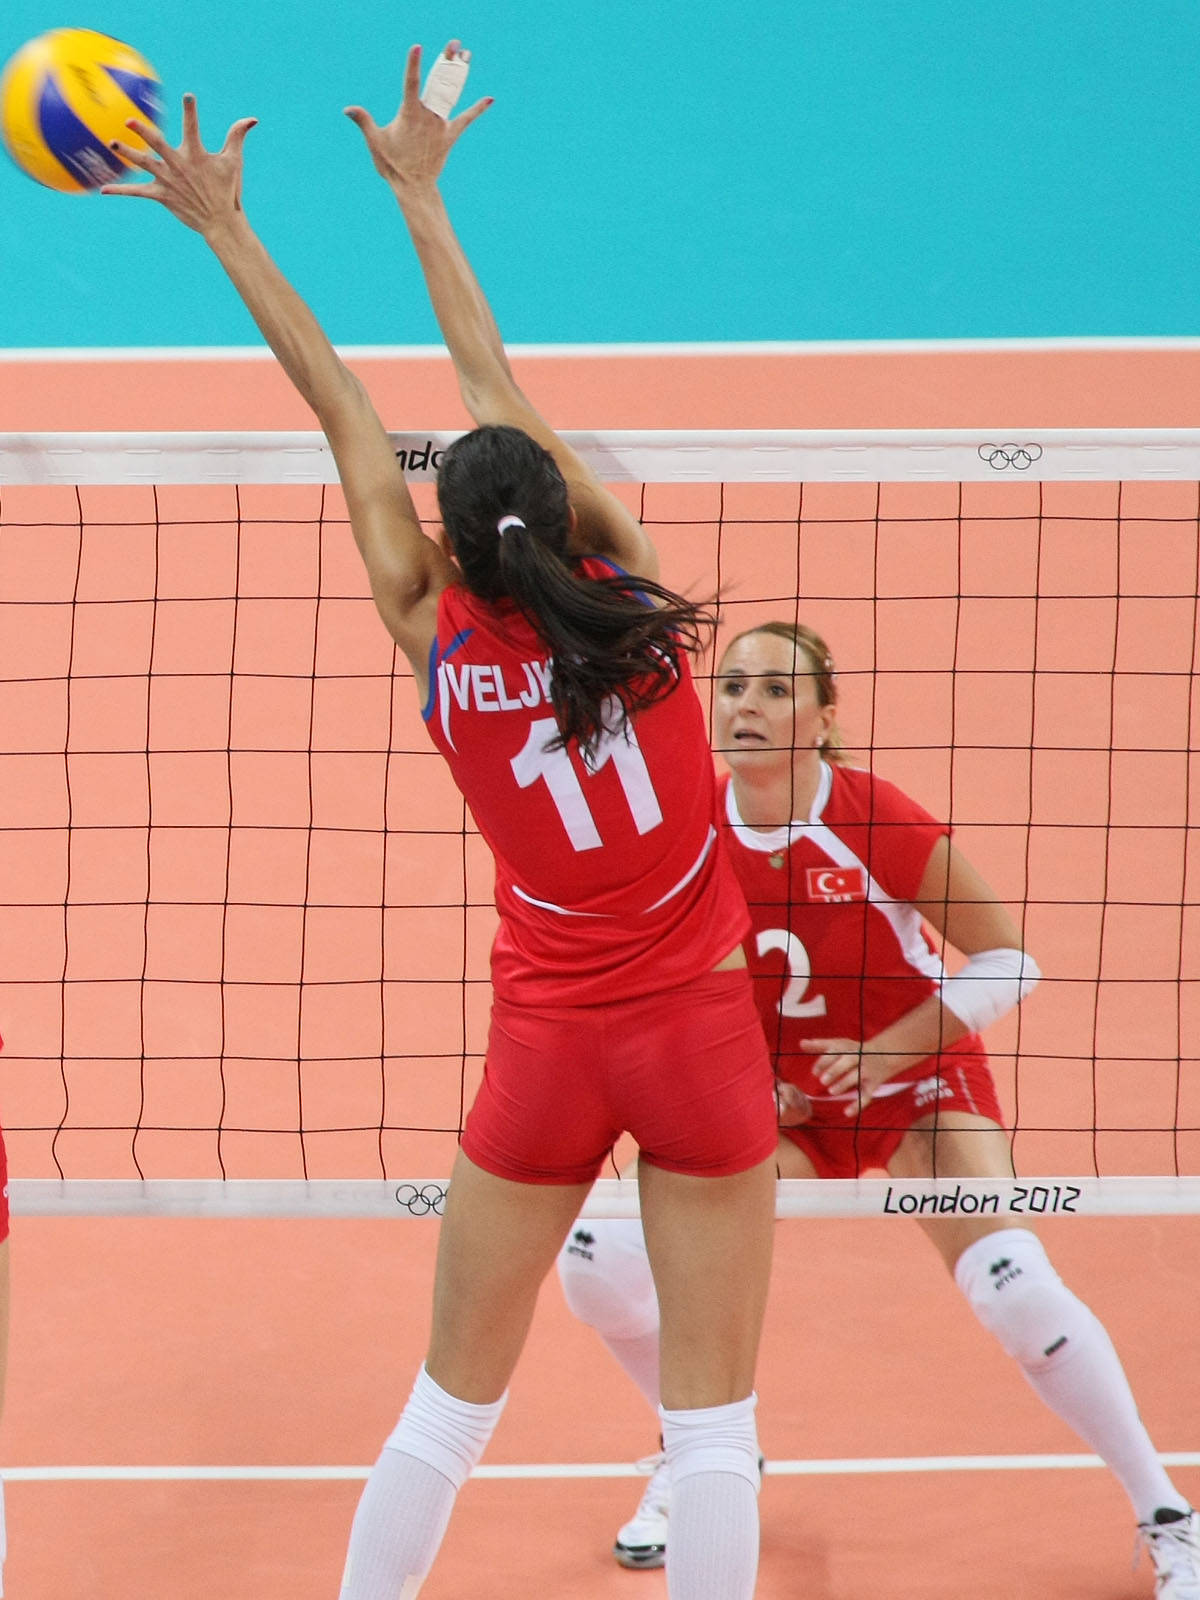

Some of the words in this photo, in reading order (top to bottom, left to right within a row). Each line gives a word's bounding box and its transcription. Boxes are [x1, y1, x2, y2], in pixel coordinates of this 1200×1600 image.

[395, 440, 446, 471] ndo
[510, 694, 664, 852] 11
[755, 929, 827, 1018] 2
[883, 1185, 1000, 1214] London
[1009, 1186, 1081, 1213] 2012
